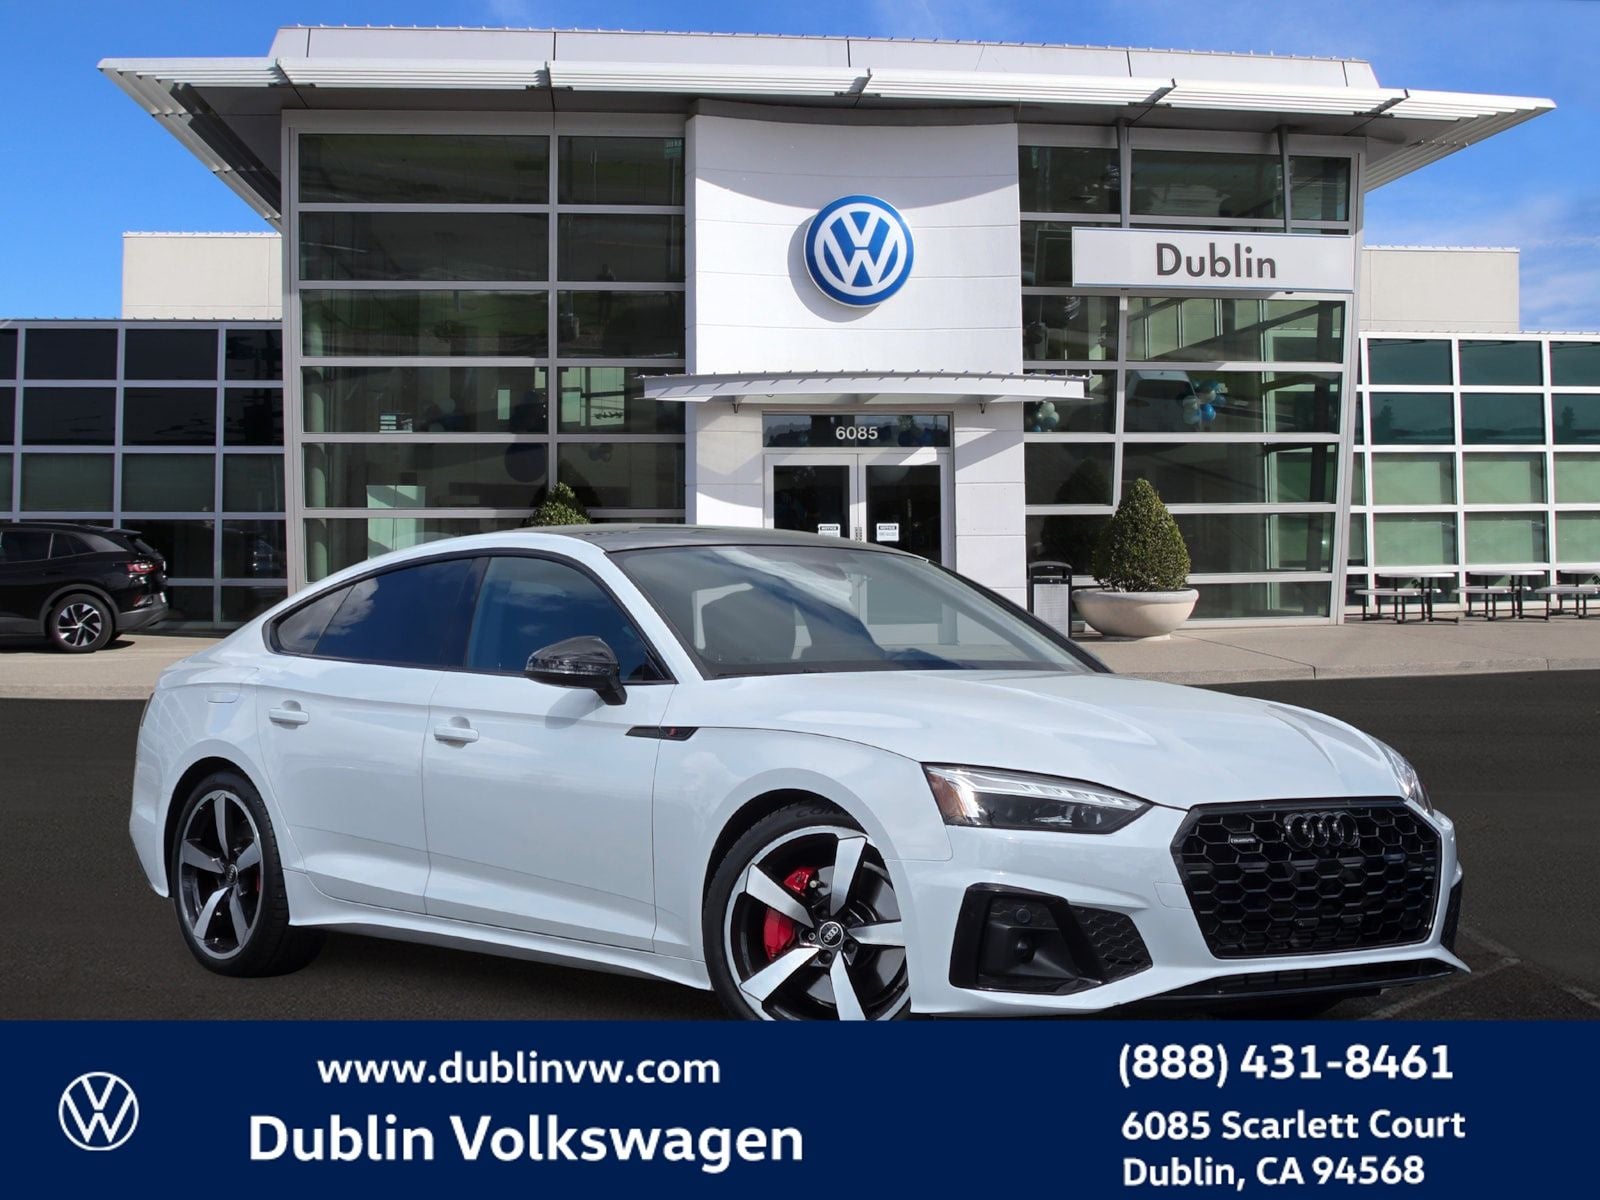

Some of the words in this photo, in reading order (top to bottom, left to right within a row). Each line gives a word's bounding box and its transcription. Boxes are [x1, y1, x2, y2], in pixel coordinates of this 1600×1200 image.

[812, 202, 908, 300] VW
[1156, 242, 1277, 279] Dublin
[835, 426, 878, 440] 6085
